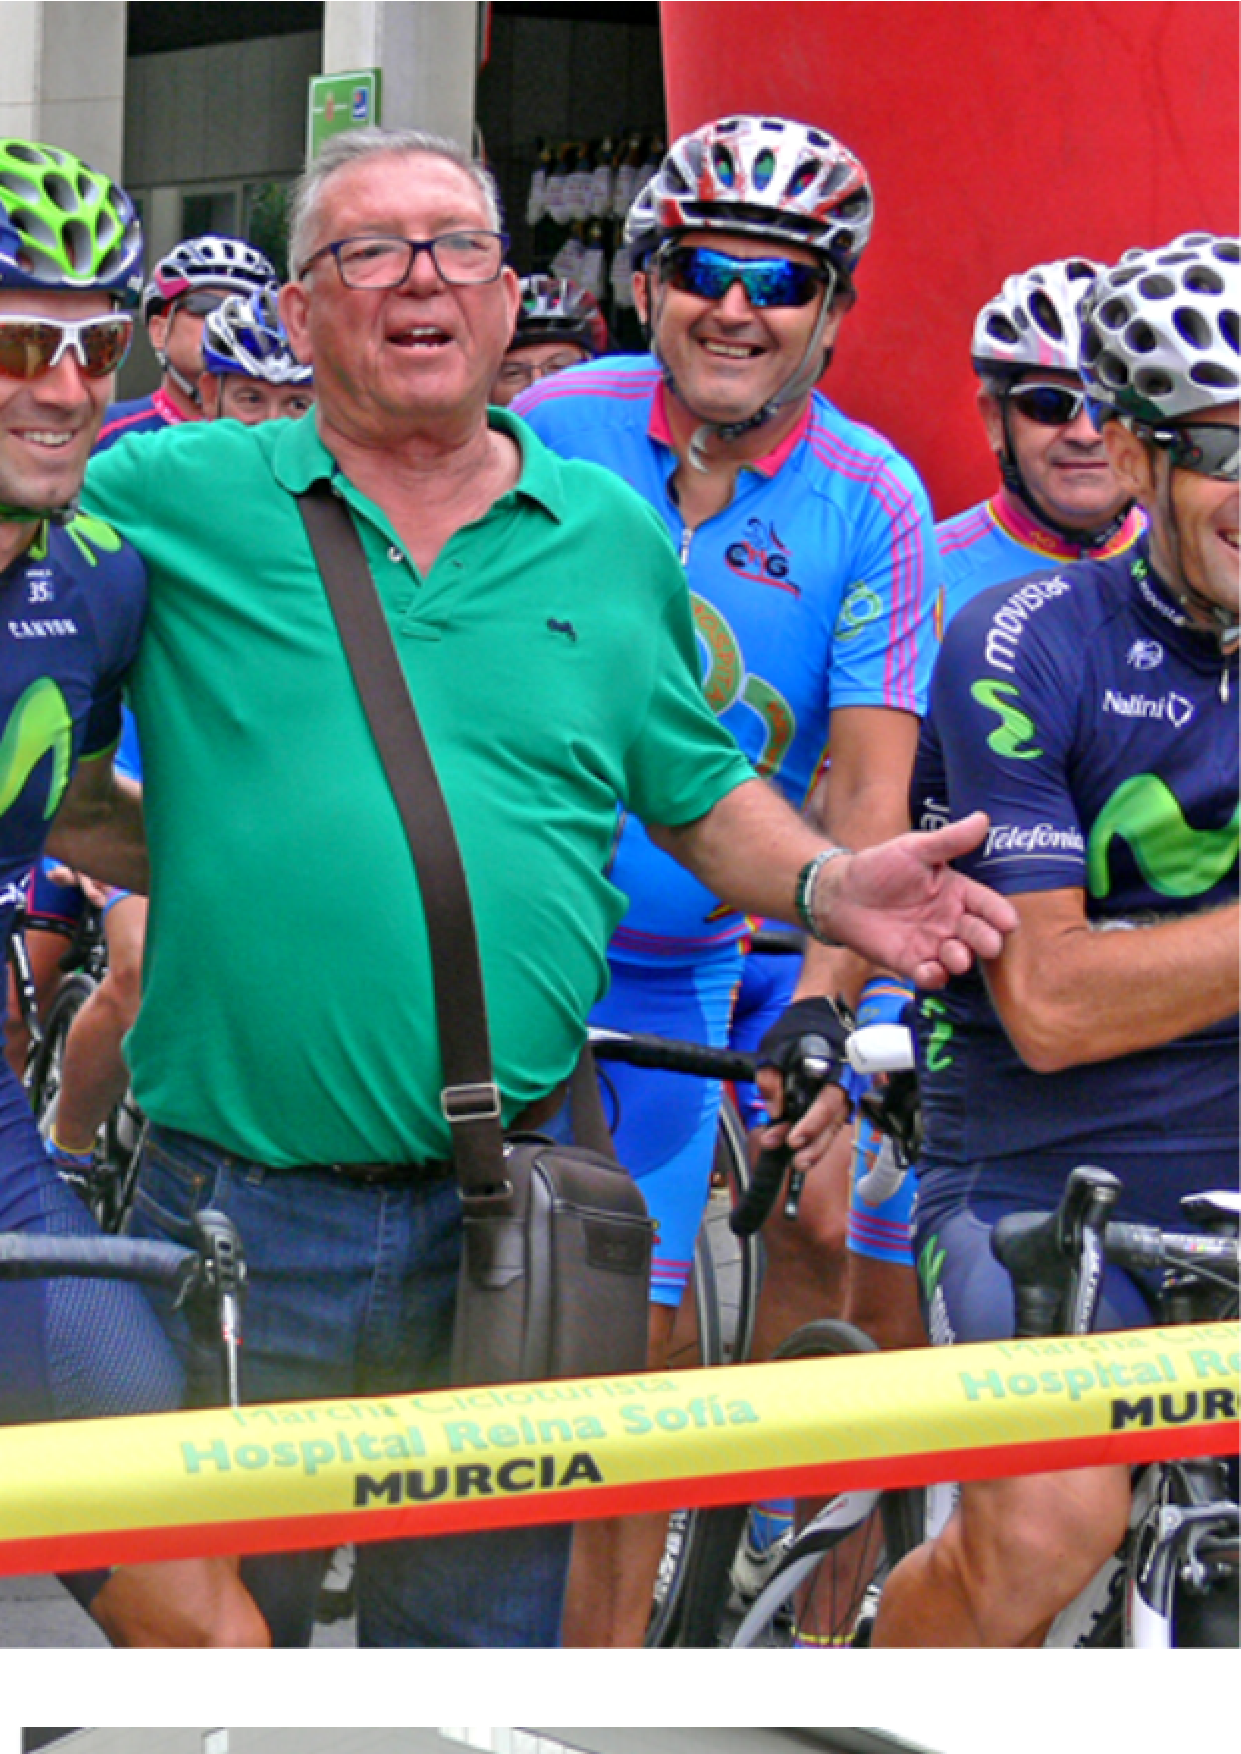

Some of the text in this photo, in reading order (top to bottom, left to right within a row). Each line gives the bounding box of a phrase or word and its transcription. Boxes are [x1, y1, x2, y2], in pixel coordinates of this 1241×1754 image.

[984, 574, 1072, 674] movistar
[1102, 687, 1166, 720] Nalini
[411, 1375, 678, 1415] Cicloturista
[958, 1353, 1178, 1401] Hospital
[1110, 1387, 1239, 1430] MUR
[180, 1394, 760, 1475] Hospital Reina Sofía
[354, 1452, 604, 1507] MURCIA
